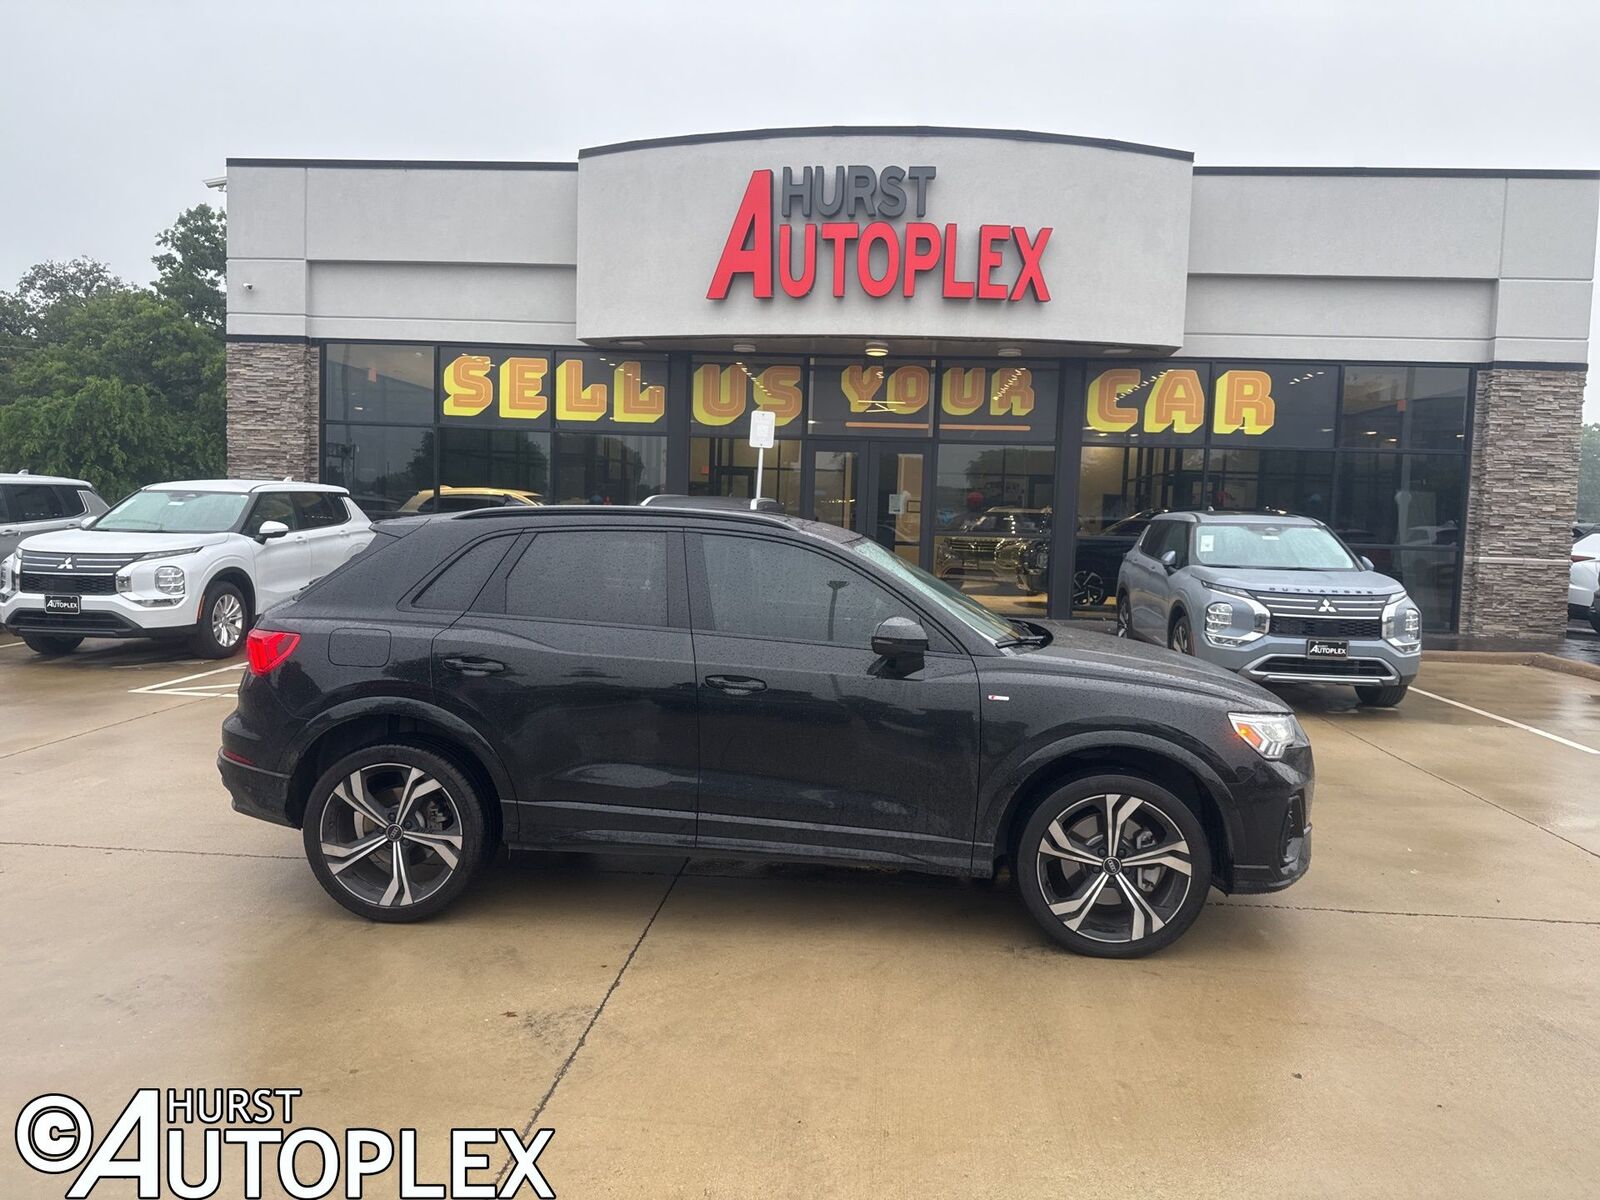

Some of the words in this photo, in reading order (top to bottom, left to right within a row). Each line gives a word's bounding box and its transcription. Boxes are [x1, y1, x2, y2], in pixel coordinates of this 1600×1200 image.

[781, 165, 937, 218] HURST
[706, 169, 1053, 302] AUTOPLEX
[443, 355, 666, 424] SELL
[692, 364, 803, 427] US
[841, 365, 1036, 416] YOUR
[1086, 368, 1275, 435] CAR
[46, 600, 78, 608] AUTOPLEX
[1309, 644, 1347, 655] AUTOPLEX
